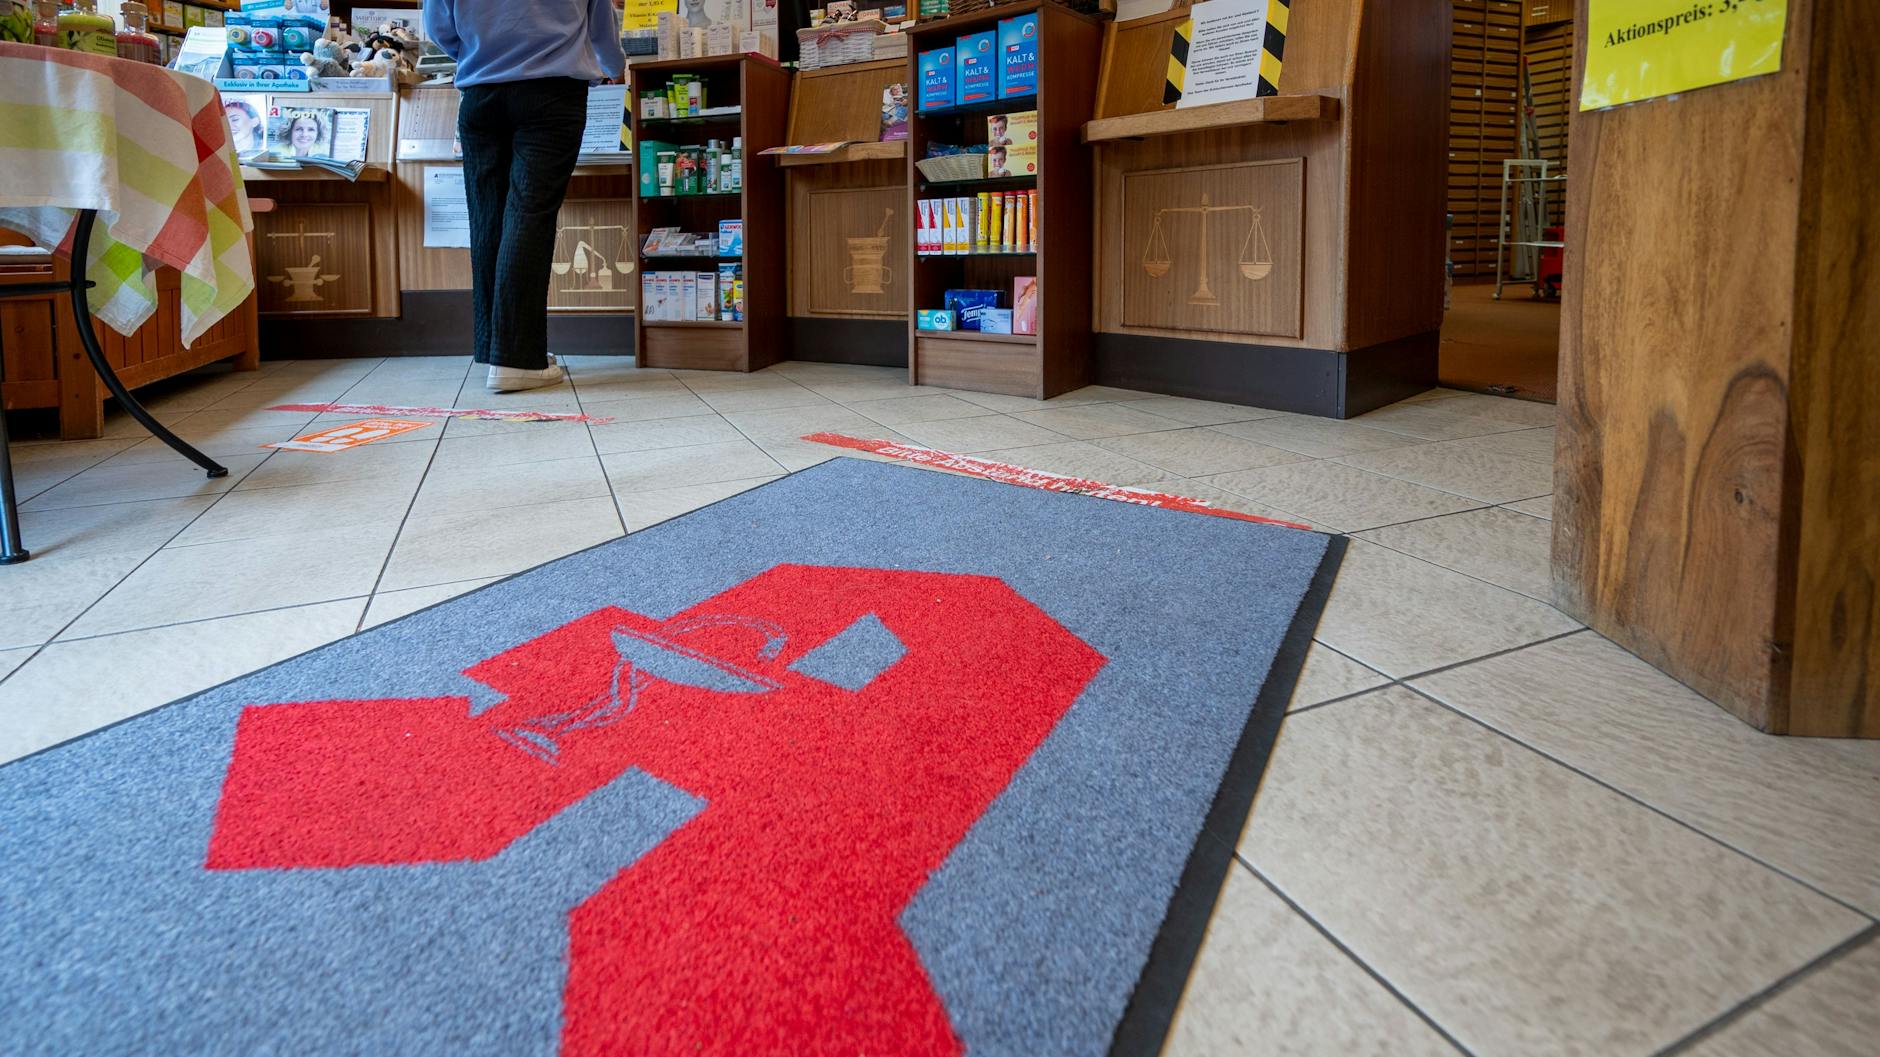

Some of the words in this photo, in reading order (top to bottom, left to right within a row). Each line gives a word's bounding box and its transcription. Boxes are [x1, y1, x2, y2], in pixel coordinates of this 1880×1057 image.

[1604, 3, 1713, 48] Aktionspreis:
[1007, 54, 1027, 64] KALT
[1028, 52, 1035, 61] &
[965, 67, 982, 76] KALT
[983, 66, 989, 74] &
[1007, 71, 1034, 80] KOMPRESSE
[271, 81, 299, 89] Apotheke
[926, 77, 941, 86] KALT
